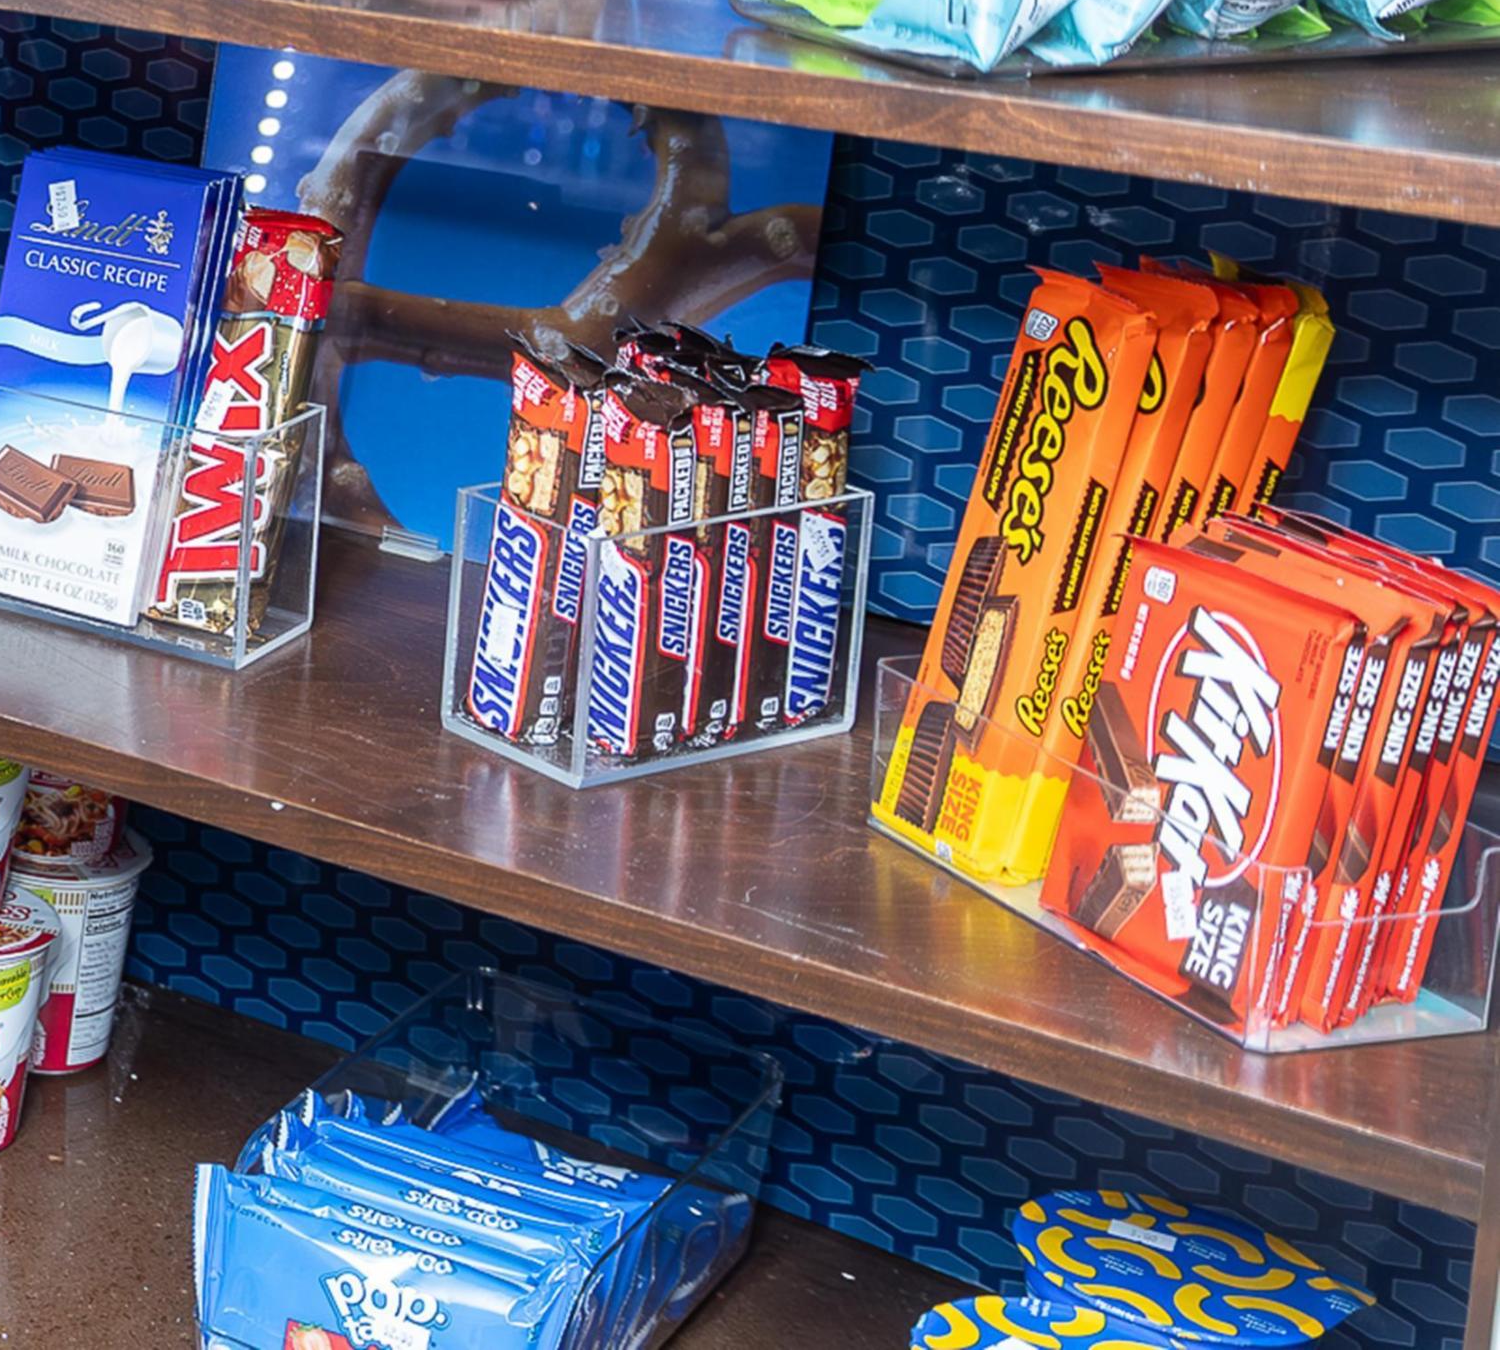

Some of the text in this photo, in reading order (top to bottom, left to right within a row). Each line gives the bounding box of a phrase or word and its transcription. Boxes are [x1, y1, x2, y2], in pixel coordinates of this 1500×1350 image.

[25, 249, 168, 293] CLASSIC RECIPE
[30, 332, 59, 351] MILK
[1042, 319, 1056, 340] 200
[734, 442, 750, 508] PACKED
[780, 444, 797, 506] PACKED
[985, 364, 1034, 502] PEANUT BUTTER CUPS
[1002, 317, 1109, 567] Reese's
[673, 447, 693, 520] PACKED
[1088, 489, 1103, 520] CUPS
[19, 571, 41, 588] WT
[43, 578, 60, 593] 4.4
[63, 583, 83, 601] OZ
[84, 589, 118, 612] (125g)
[34, 553, 121, 586] CHOCOLATE
[106, 542, 125, 555] 160
[553, 503, 597, 620] SNICKERS
[720, 527, 749, 641] SNICKERS
[768, 526, 797, 641] SNICKERS
[662, 539, 694, 655] SNICKERS
[1015, 629, 1069, 736] Reese's
[1061, 631, 1111, 738] Reese's
[1324, 645, 1364, 750] KING SIZE
[1341, 657, 1385, 762] KING SIZE
[1381, 659, 1425, 765] KING SIZE
[1415, 650, 1457, 754] KING SIZE
[1438, 641, 1482, 743] KING SIZE
[1465, 687, 1490, 737] KING
[939, 770, 983, 842] KING SIZE
[1186, 900, 1224, 979] SIZE
[1211, 903, 1251, 990] KING
